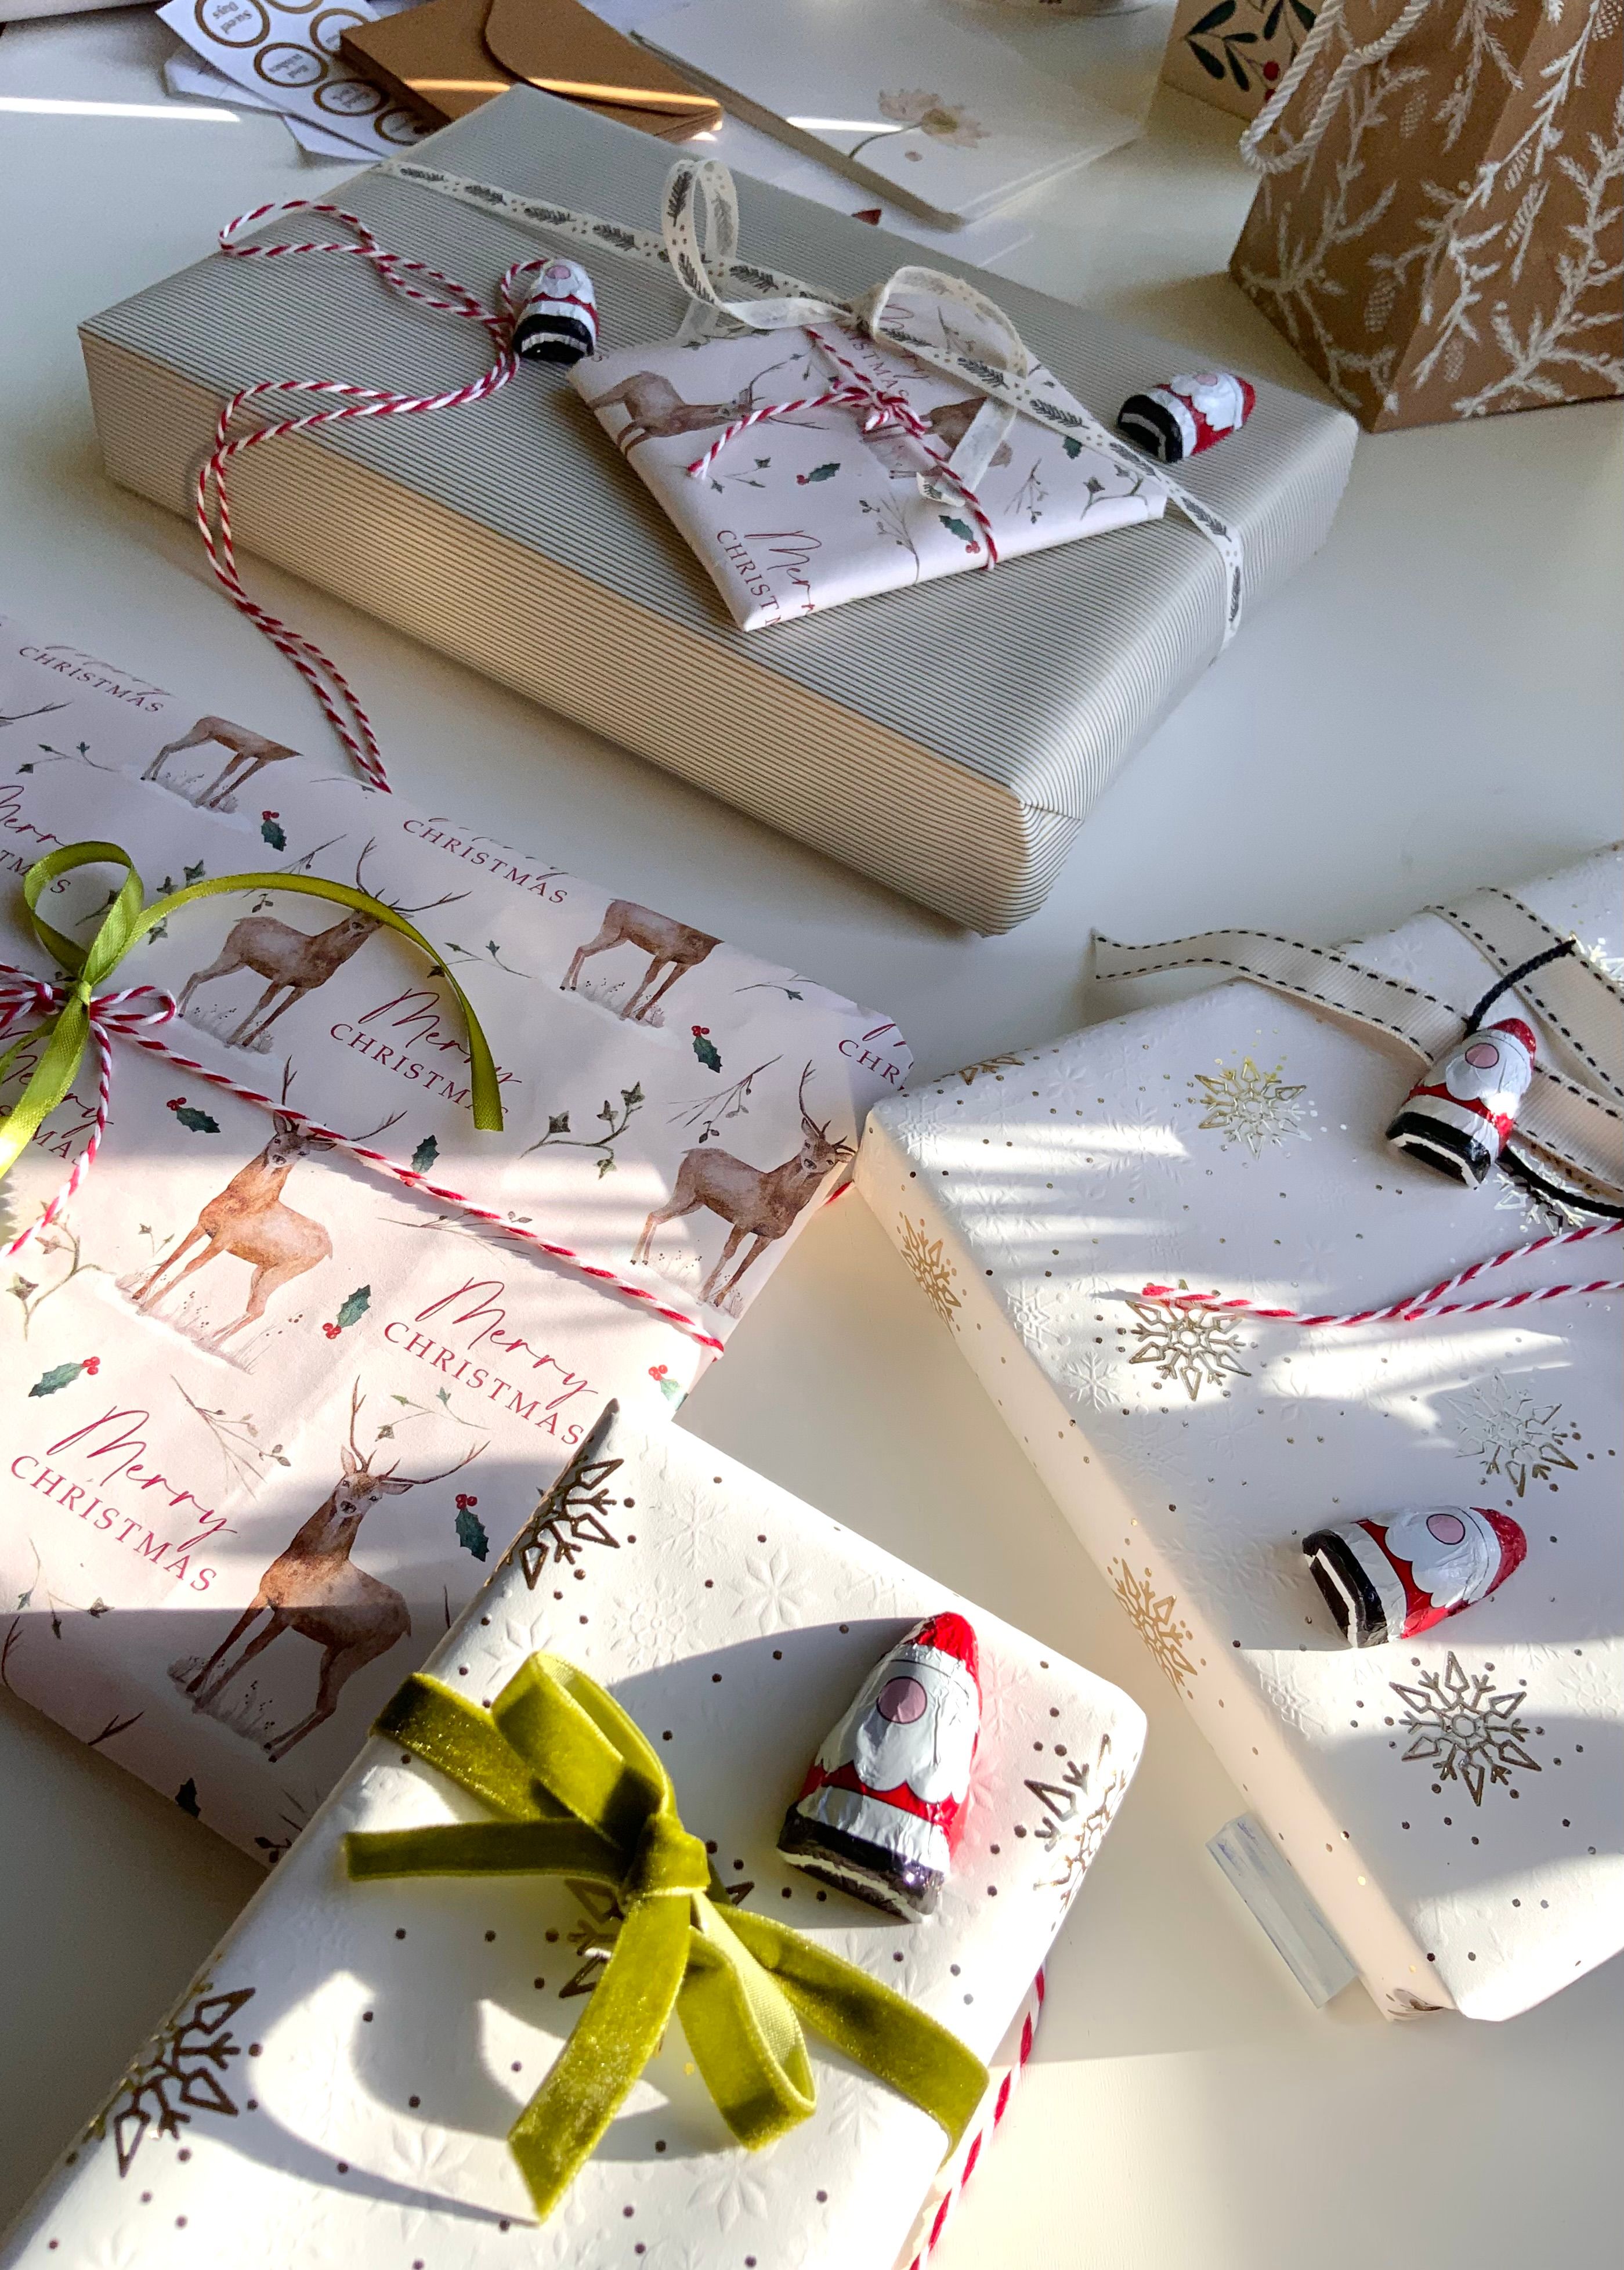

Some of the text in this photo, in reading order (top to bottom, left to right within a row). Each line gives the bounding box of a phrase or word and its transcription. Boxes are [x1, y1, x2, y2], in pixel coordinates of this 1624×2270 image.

[19, 646, 164, 712] CHRISTMAS
[403, 819, 567, 903] CHRISTMAS
[330, 1024, 509, 1114] CHRISTM
[384, 1321, 584, 1445] CHRISTMAS
[415, 1277, 598, 1411] Merry
[10, 1455, 217, 1591] CHRISTMAS
[46, 1405, 237, 1552] Merry
